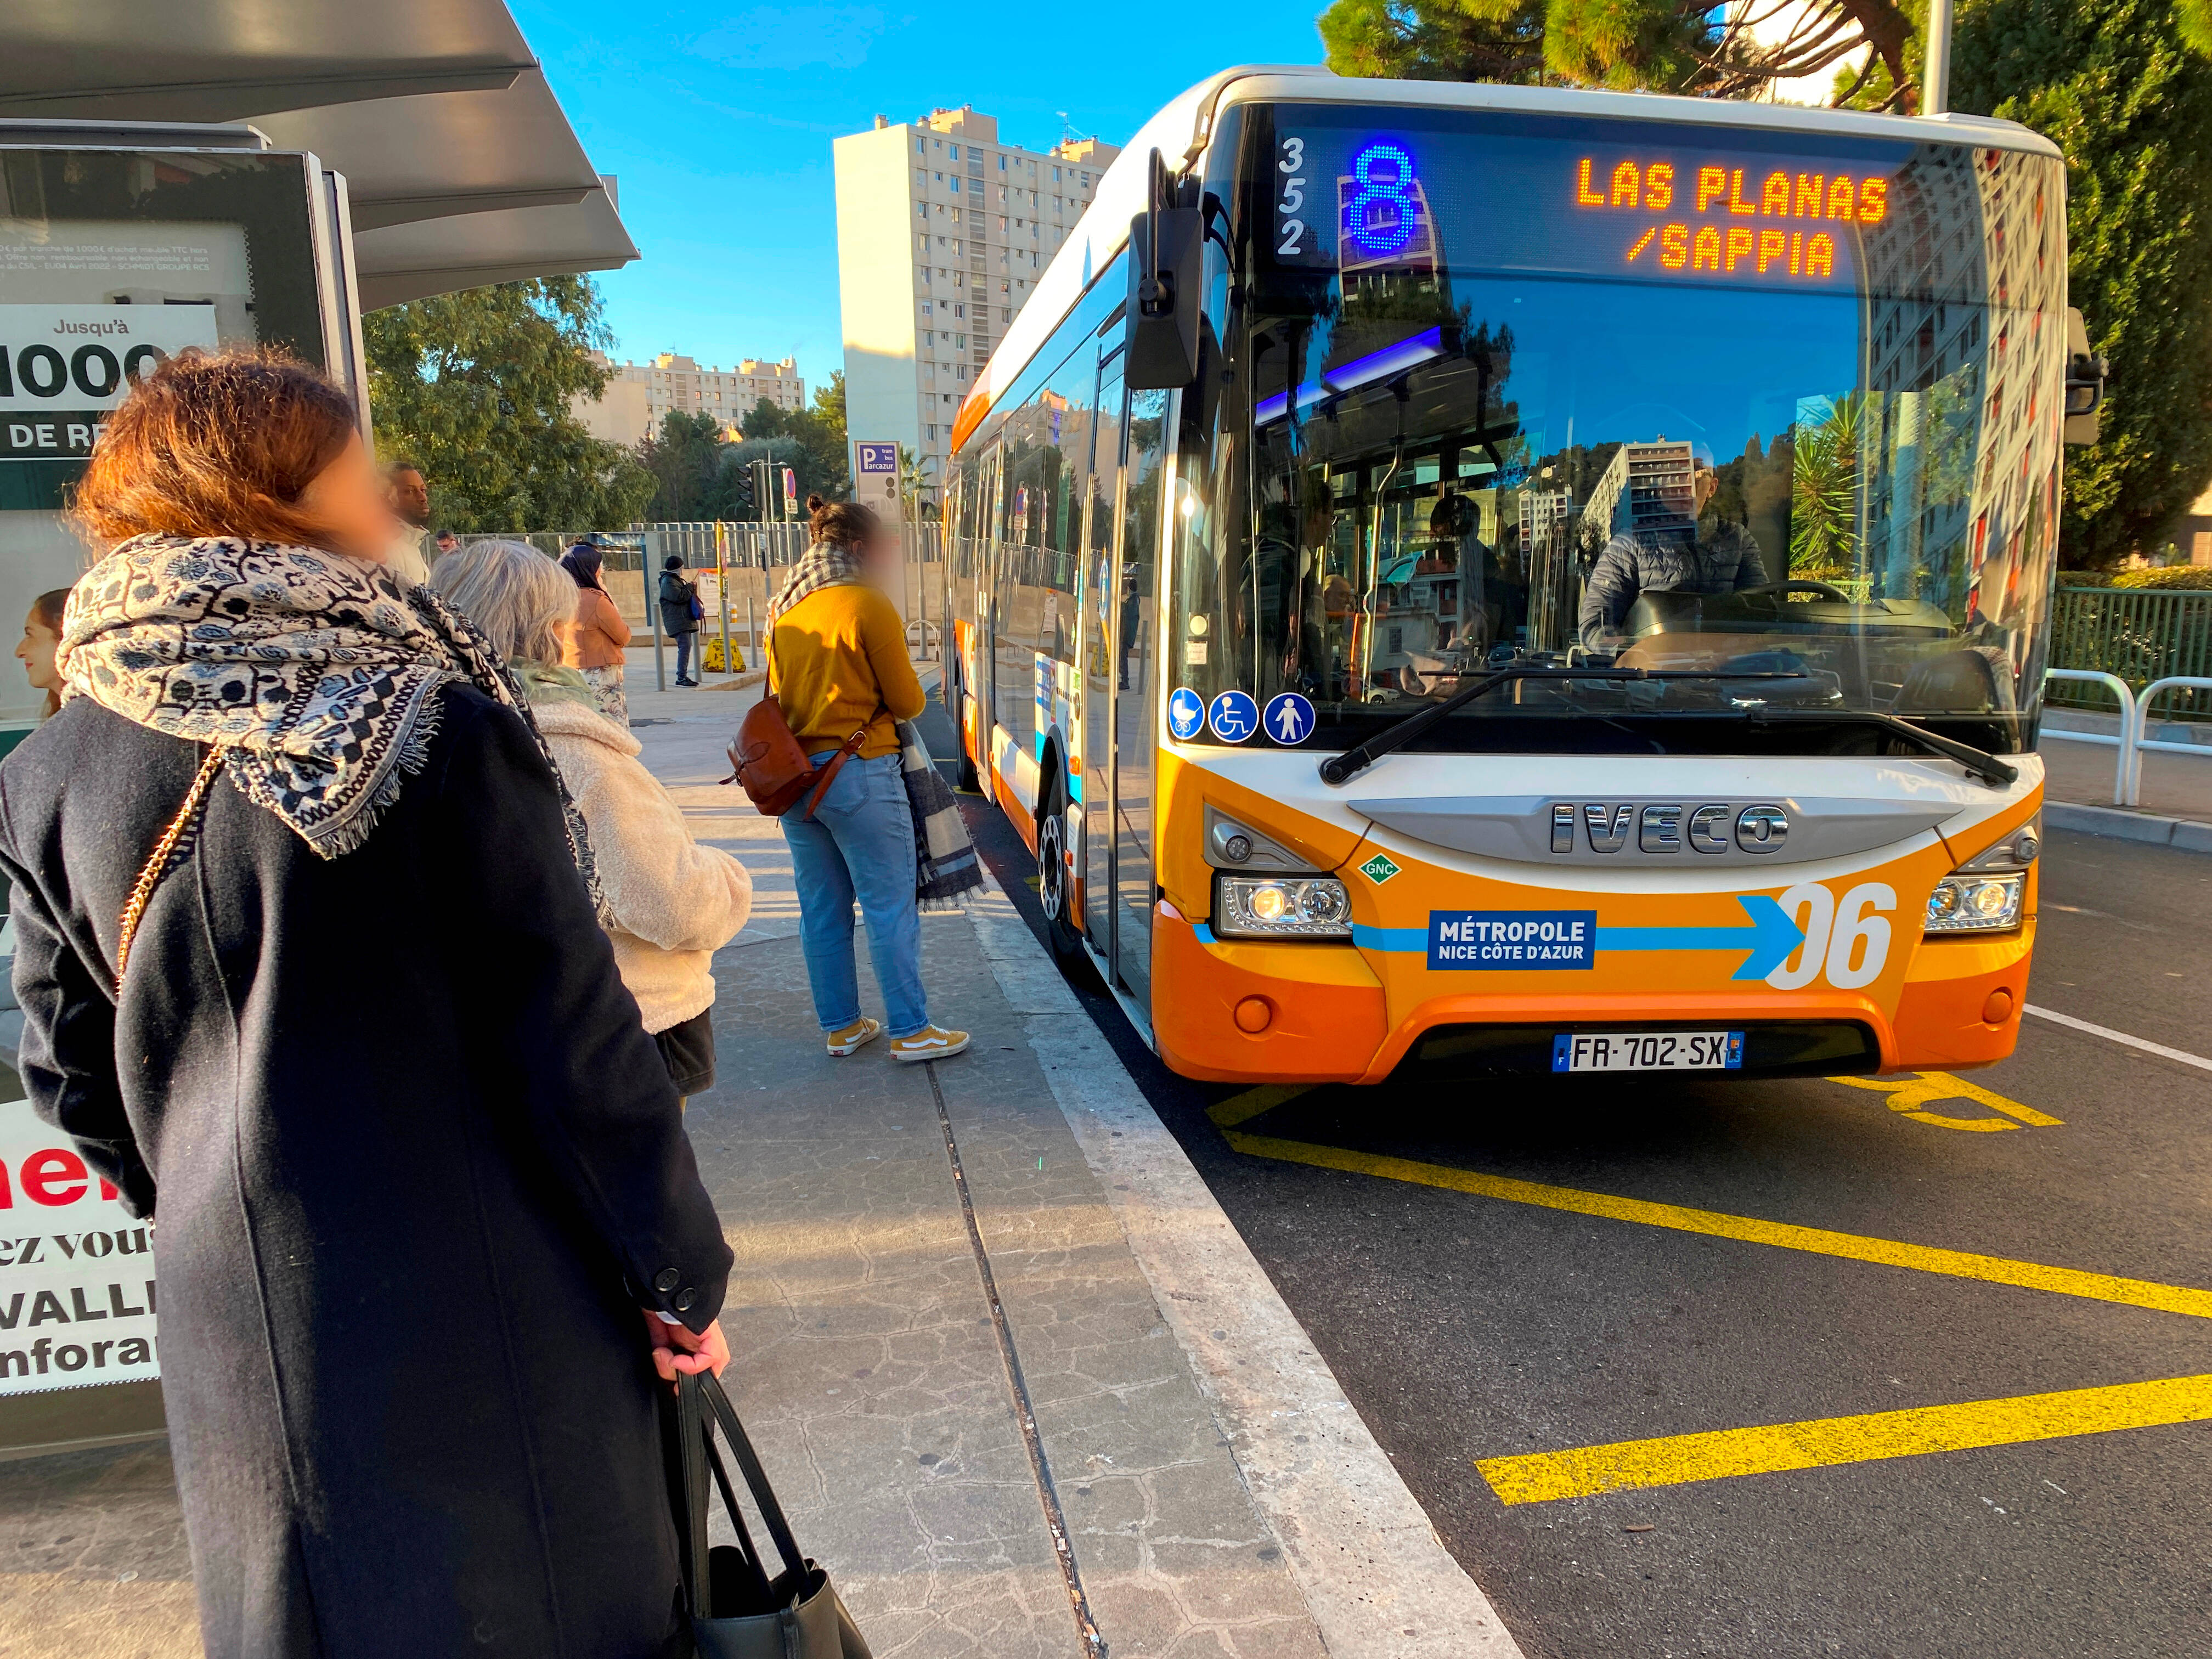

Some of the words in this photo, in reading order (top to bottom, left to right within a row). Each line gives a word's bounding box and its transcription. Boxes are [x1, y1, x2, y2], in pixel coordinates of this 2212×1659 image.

[1350, 145, 1414, 250] 8
[1578, 158, 1674, 210] LAS
[1697, 167, 1888, 222] PLANAS
[1628, 223, 1833, 276] /SAPPIA
[53, 319, 129, 337] Jusqu'à
[0, 343, 206, 397] 1000
[9, 424, 57, 448] DE
[1551, 804, 1788, 854] IVECO
[1366, 863, 1393, 875] GNC
[1440, 916, 1585, 941] MÉTROPOLE
[1764, 882, 1897, 991] 06
[1438, 946, 1477, 960] NICE
[1481, 942, 1522, 960] CÔTE
[1527, 946, 1584, 960] D'AZUR
[1573, 1036, 1725, 1068] FR-702-SX
[50, 1227, 156, 1260] vou
[0, 1336, 161, 1379] nfora
